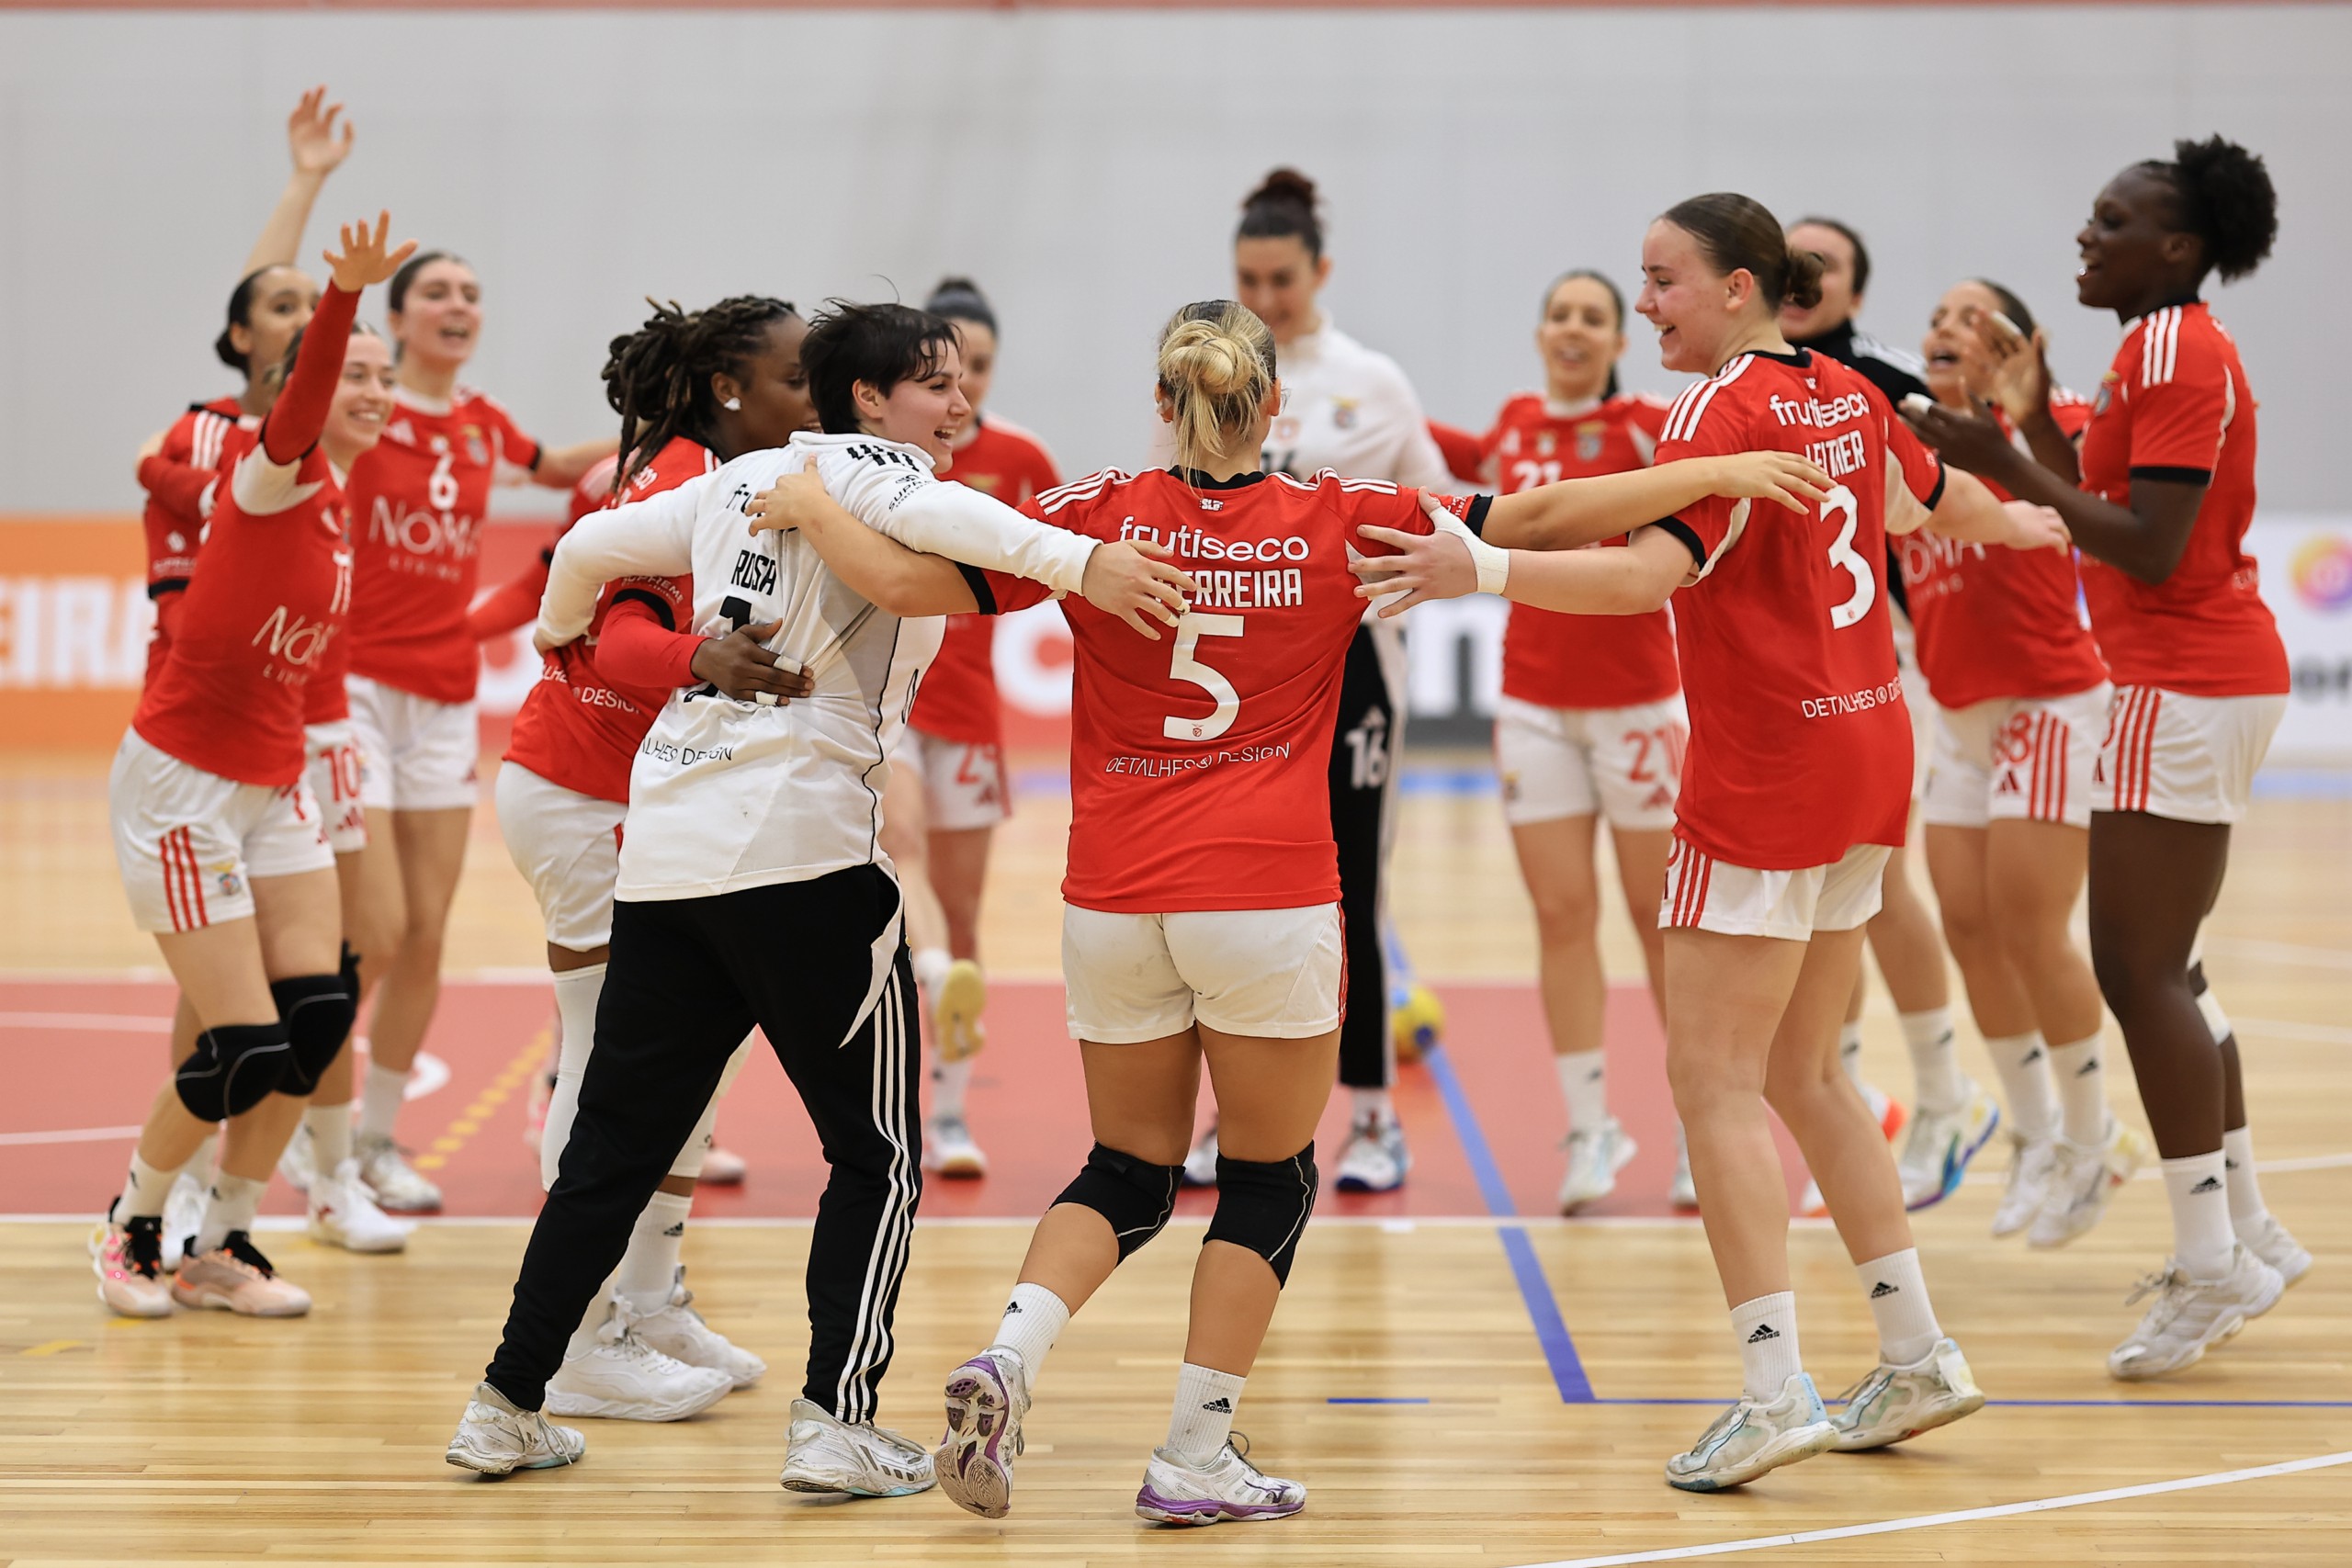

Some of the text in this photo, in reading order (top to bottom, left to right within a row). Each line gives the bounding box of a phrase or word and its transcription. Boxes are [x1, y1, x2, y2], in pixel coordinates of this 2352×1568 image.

[429, 450, 458, 512] 6
[730, 549, 777, 596] ROSA
[1819, 484, 1876, 630] 3
[1156, 568, 1303, 608] ERREIRA
[1163, 612, 1244, 741] 5
[1802, 689, 1876, 718] DETALHES
[1344, 728, 1388, 788] 16
[1747, 1331, 1781, 1344] adidas
[1203, 1404, 1232, 1415] adidas
